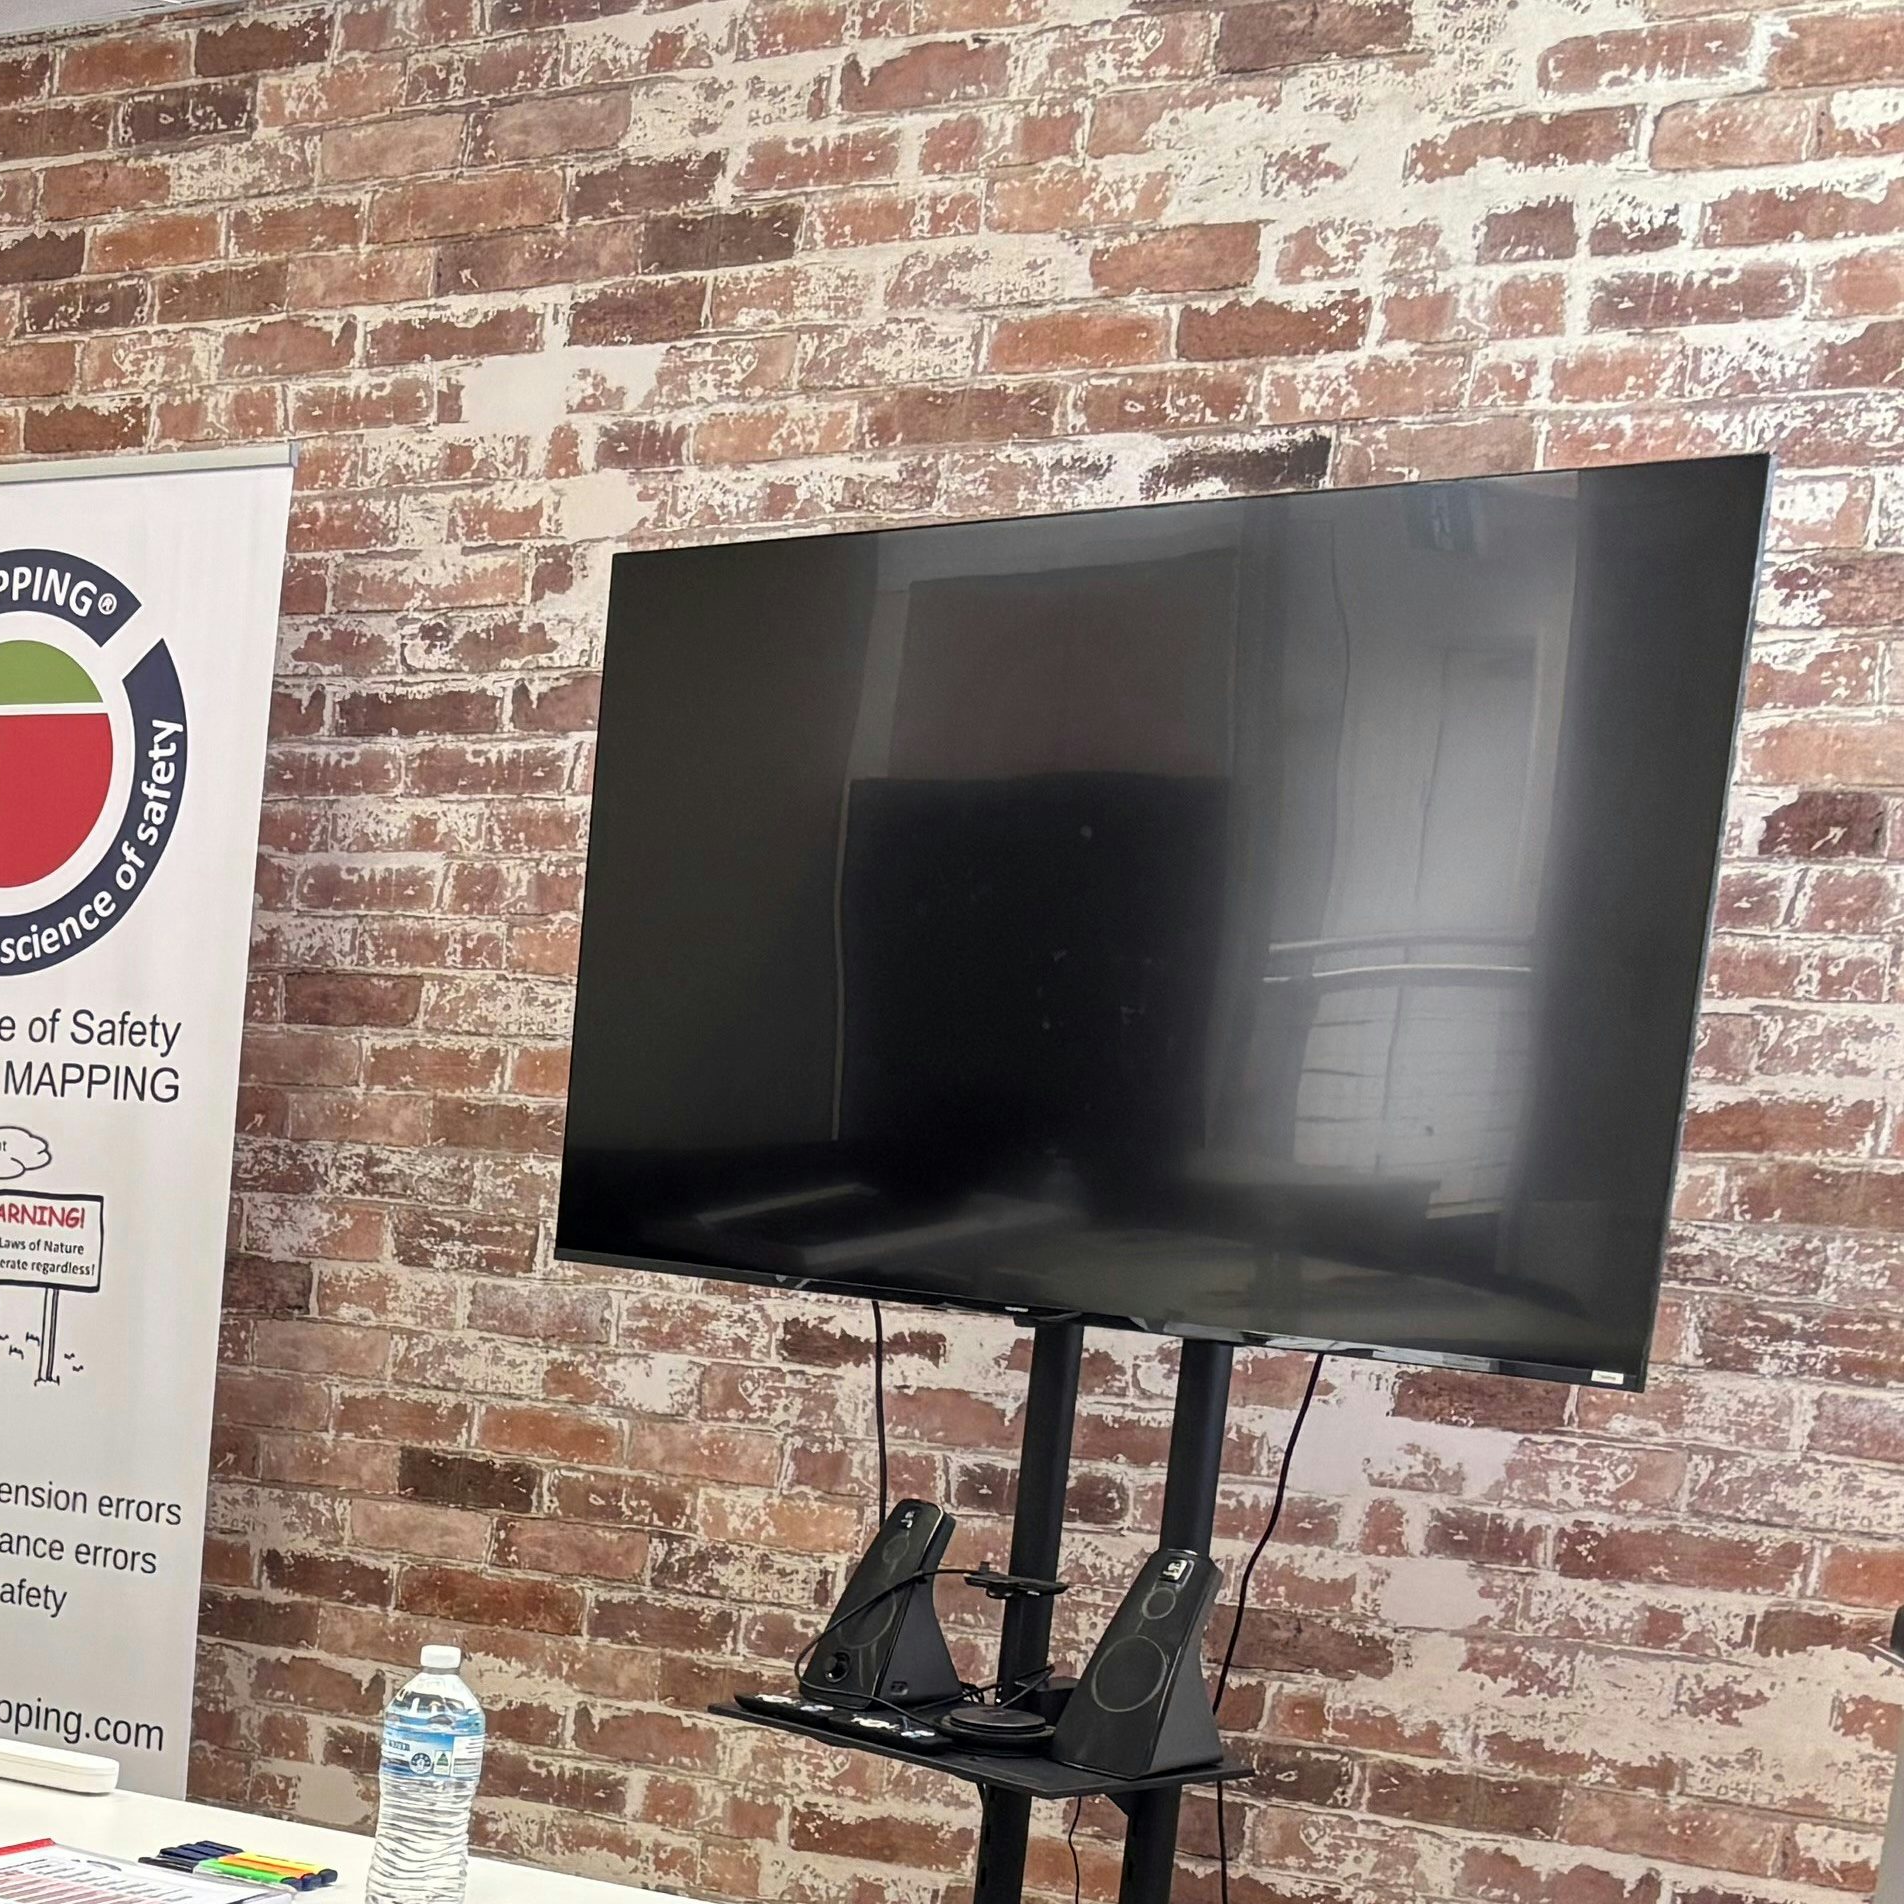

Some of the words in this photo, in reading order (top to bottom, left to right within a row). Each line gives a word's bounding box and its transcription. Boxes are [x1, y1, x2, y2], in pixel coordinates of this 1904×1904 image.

[0, 889, 117, 965] science
[114, 839, 146, 891] of
[136, 718, 184, 846] safety
[27, 1007, 62, 1043] of
[70, 1008, 182, 1058] Safety
[3, 1059, 181, 1104] MAPPING
[28, 1239, 42, 1252] of
[43, 1240, 85, 1256] Nature
[30, 1260, 96, 1277] regardless!
[97, 1493, 182, 1527] errors
[73, 1540, 158, 1576] errors
